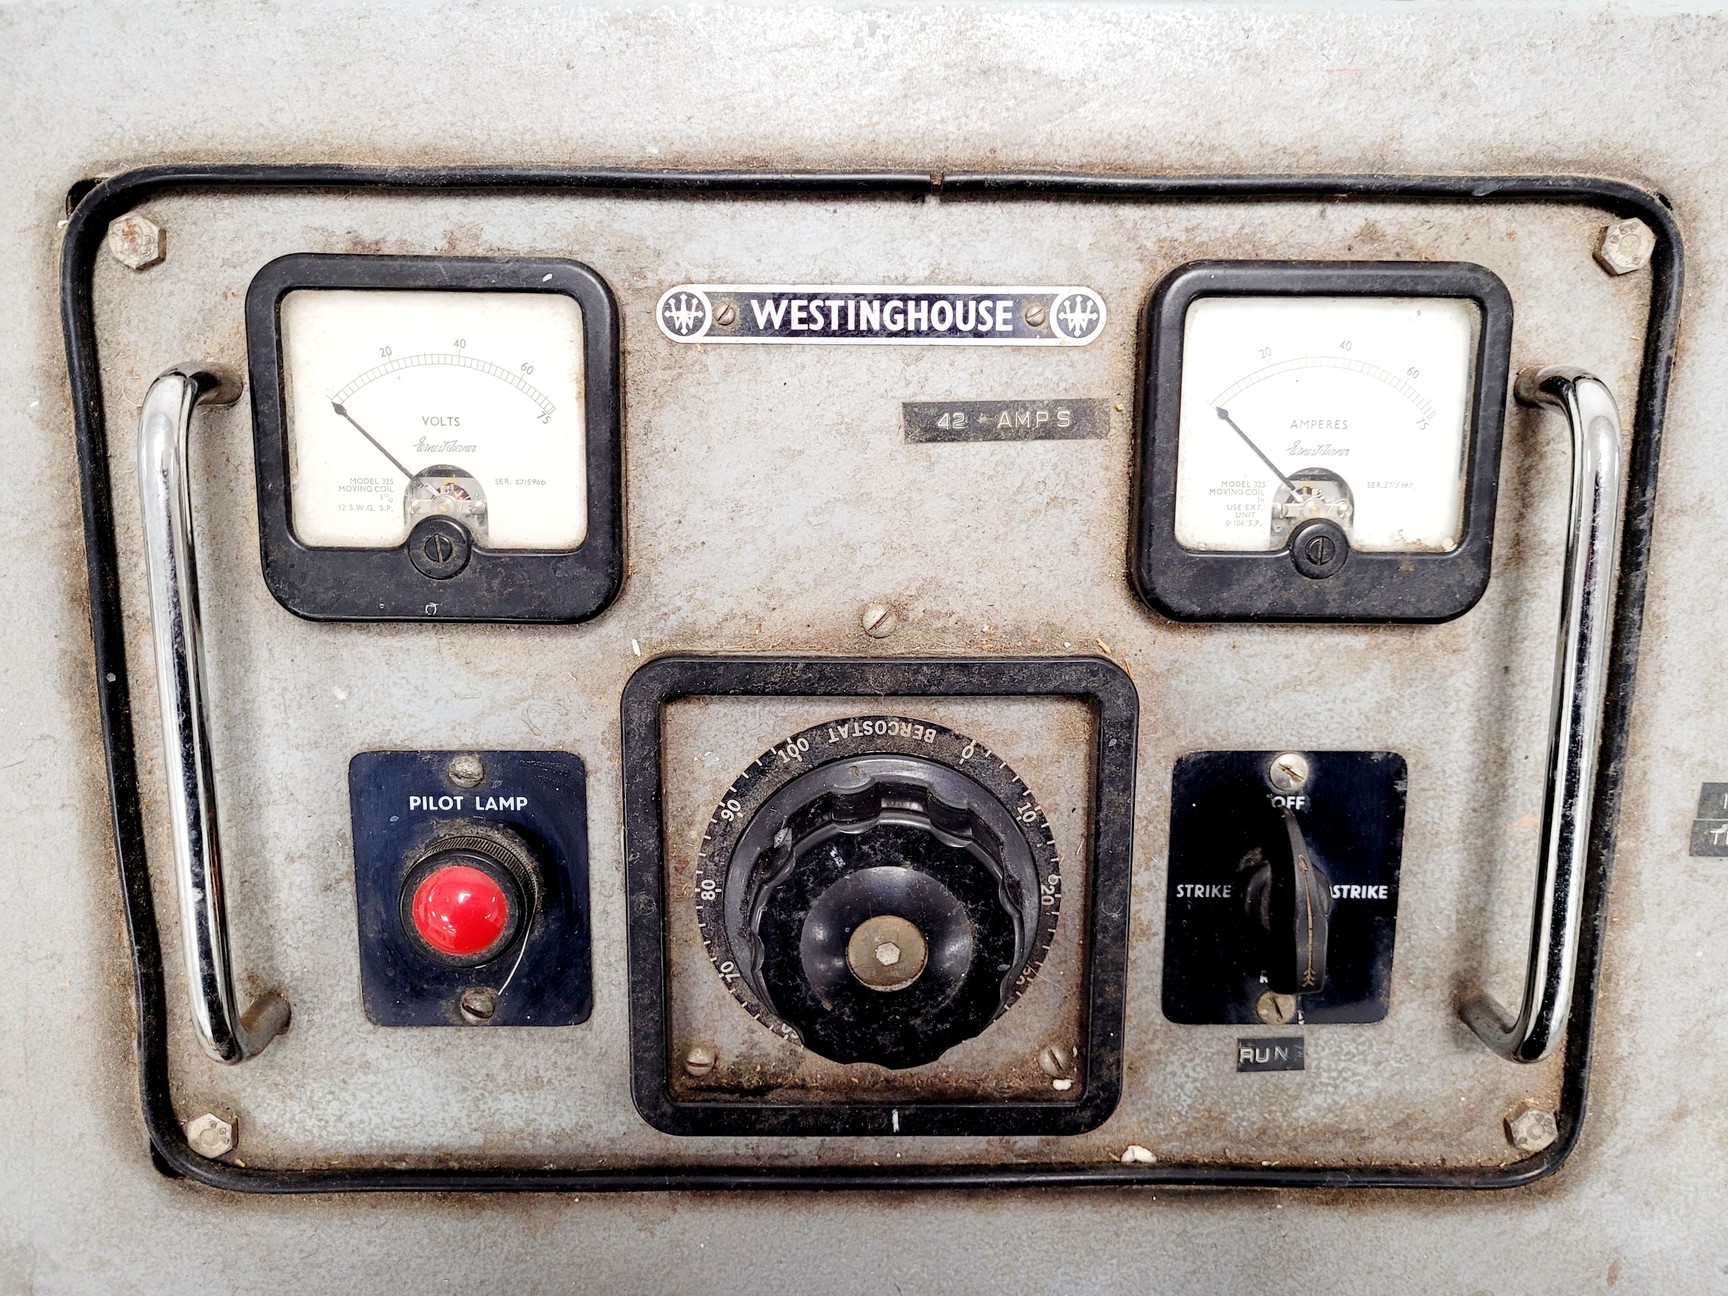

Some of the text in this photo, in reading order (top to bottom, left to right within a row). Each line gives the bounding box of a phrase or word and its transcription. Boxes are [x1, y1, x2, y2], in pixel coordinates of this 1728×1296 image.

[751, 299, 1013, 332] WESTINGHOUSE
[453, 339, 466, 349] 40
[1339, 341, 1352, 352] 40
[379, 346, 392, 358] 20
[1258, 346, 1272, 359] 20
[520, 362, 534, 375] 60
[1406, 367, 1420, 380] 60
[422, 416, 461, 427] VOLTS
[536, 411, 551, 425] 75
[937, 410, 1071, 430] 42 AMPS
[1289, 419, 1348, 430] AMPERES
[1415, 417, 1429, 431] 75
[349, 477, 394, 485] MODEL 325
[494, 477, 512, 486] SER.
[1221, 480, 1266, 488] MODEL 325
[338, 485, 394, 493] MOVING COIL
[1209, 488, 1265, 496] MOVING COIL
[1235, 511, 1256, 519] UNIT
[777, 737, 810, 764] 100
[828, 718, 937, 745] BERCOSTAT
[409, 795, 528, 811] PILOT LAMP
[721, 798, 741, 822] 90
[1271, 796, 1305, 810] OFF
[1017, 801, 1037, 825] 10
[701, 879, 716, 901] 80
[1041, 883, 1055, 905] 20
[1176, 884, 1231, 899] STRIKE
[1332, 884, 1388, 900] STRIKE
[720, 960, 741, 983] 70
[1239, 1045, 1288, 1065] RUN
